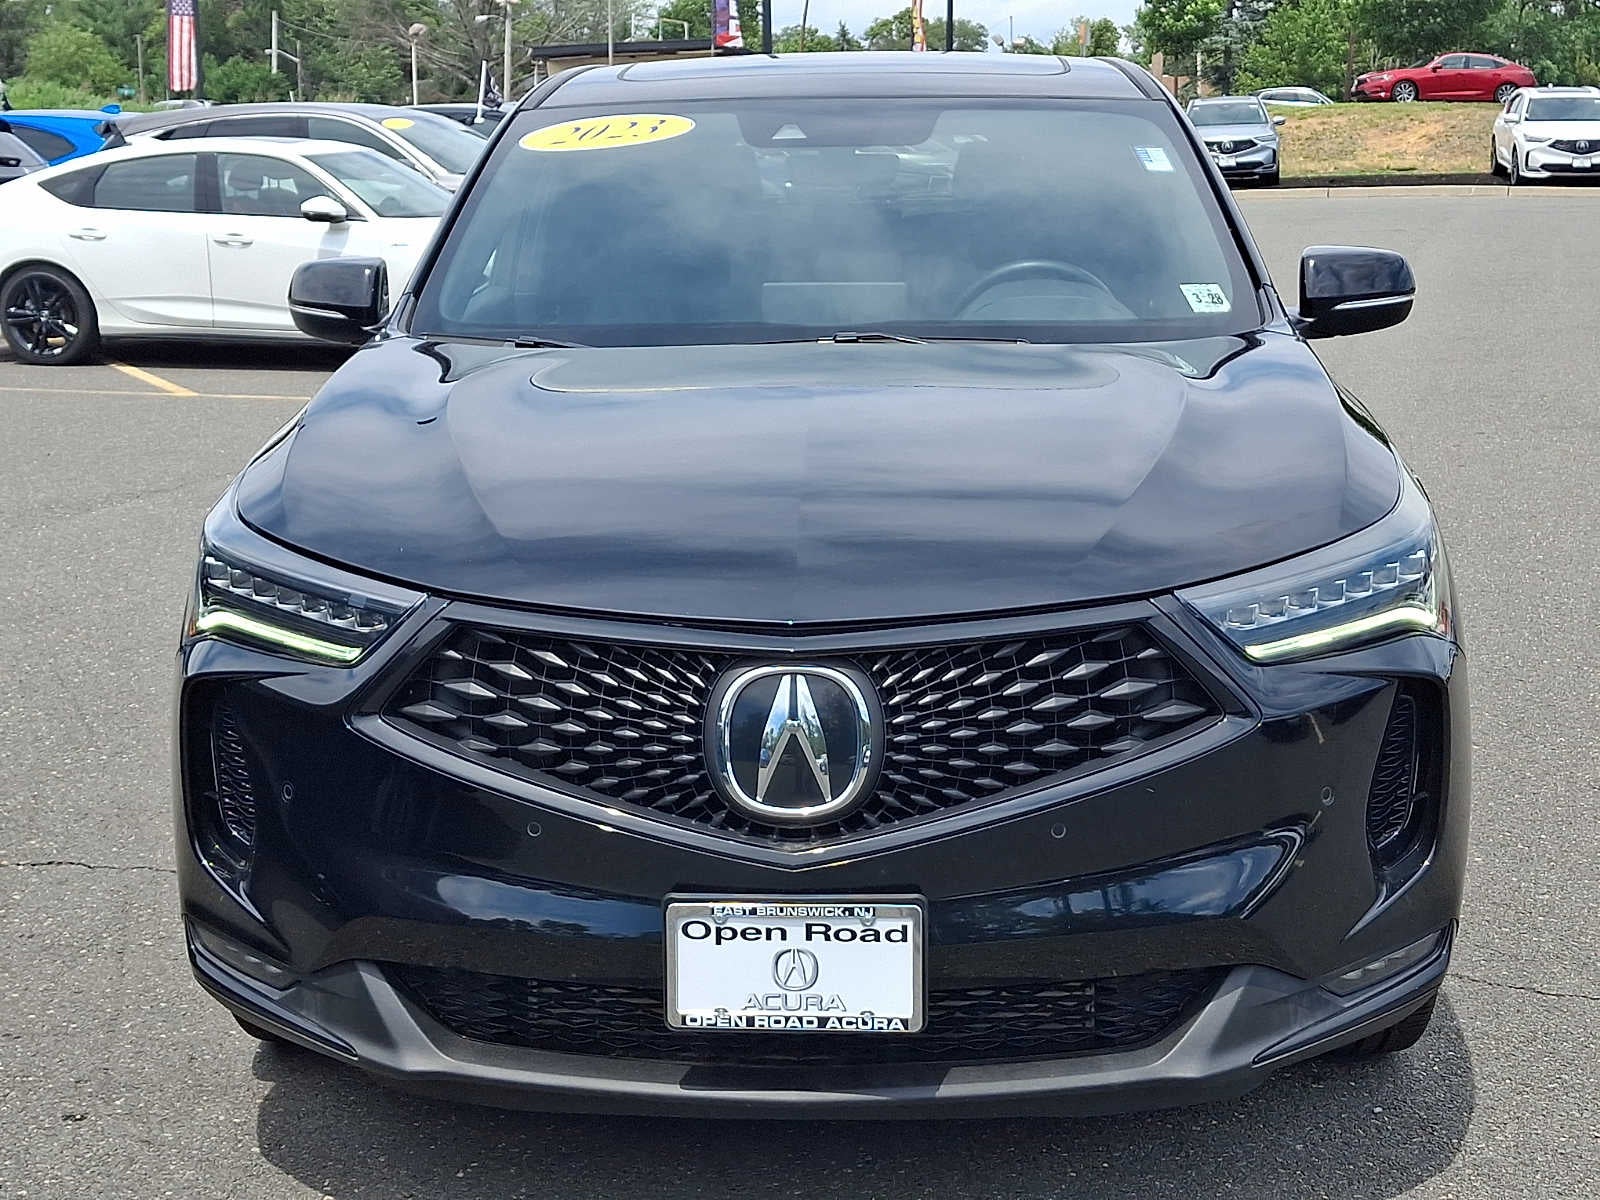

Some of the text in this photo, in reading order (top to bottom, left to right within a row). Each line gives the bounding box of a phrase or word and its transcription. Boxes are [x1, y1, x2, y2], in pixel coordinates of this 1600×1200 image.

[549, 118, 667, 146] 2023
[713, 906, 752, 917] EAST
[853, 907, 875, 918] NJ
[681, 920, 909, 946] Open Road
[740, 992, 848, 1012] ACURA
[685, 1015, 906, 1031] OPEN ROAD ACURA
